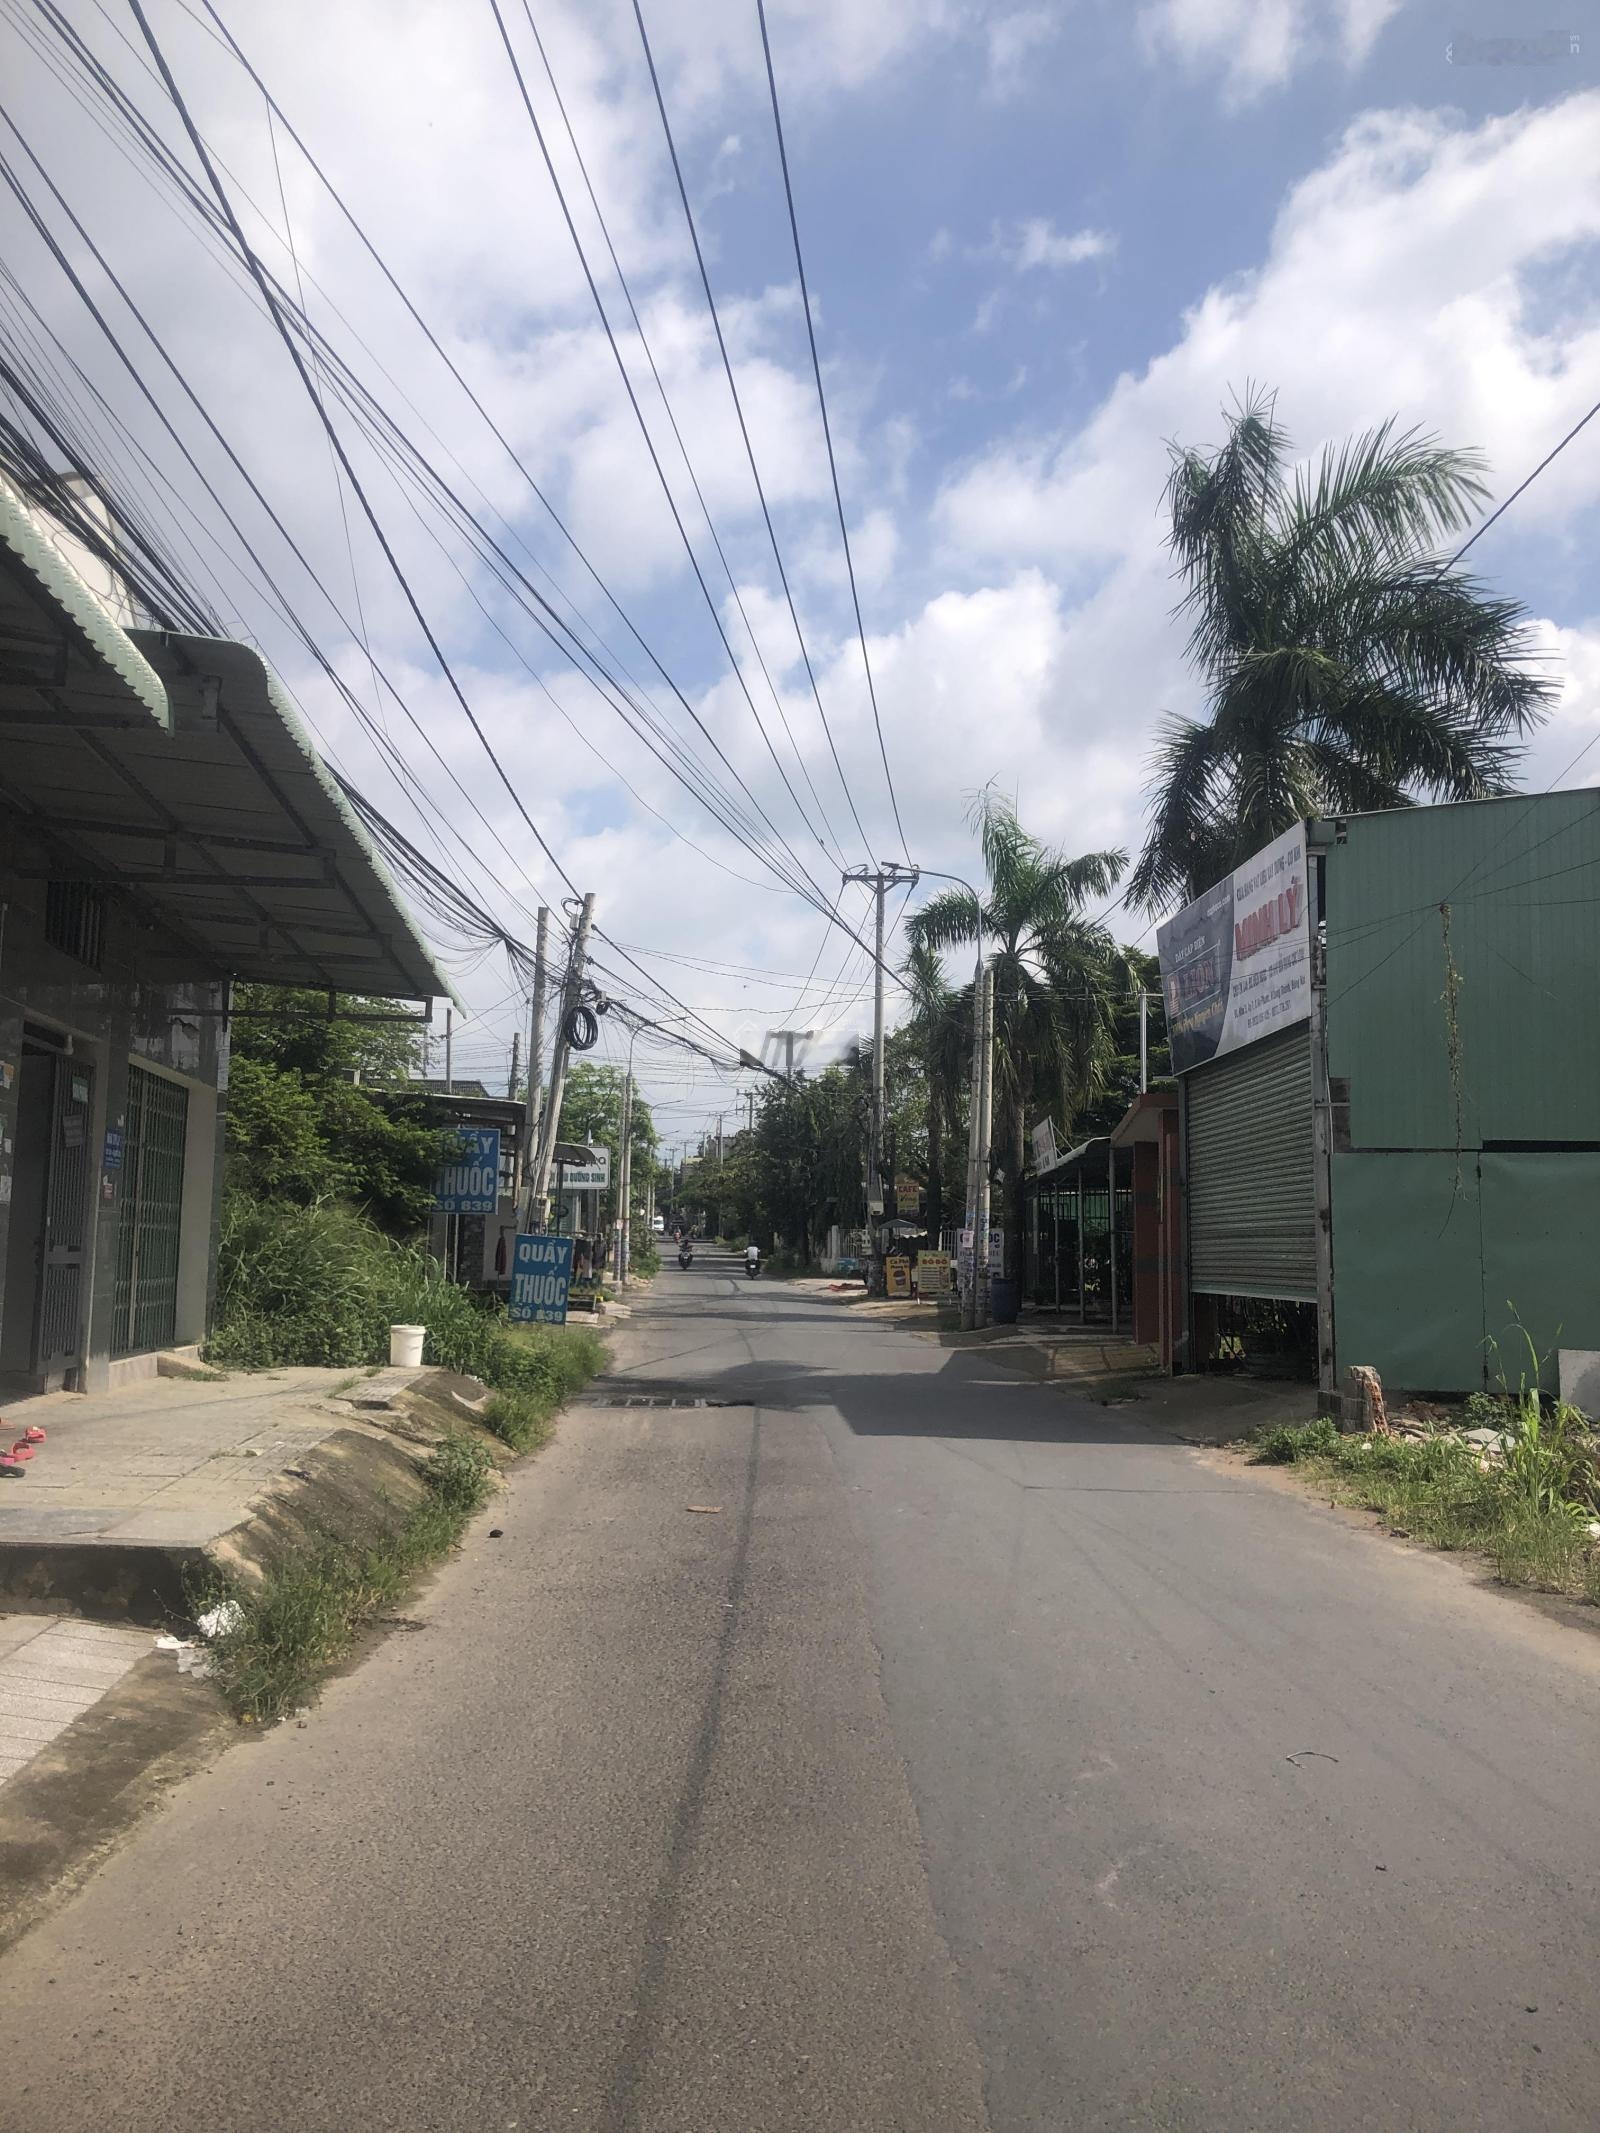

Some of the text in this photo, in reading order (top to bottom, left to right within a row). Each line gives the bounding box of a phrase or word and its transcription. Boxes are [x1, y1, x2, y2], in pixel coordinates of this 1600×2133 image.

[591, 1172, 606, 1182] SINH
[461, 1200, 493, 1212] 839
[519, 1240, 568, 1264] QUẦY
[514, 1266, 567, 1306] THUỐC
